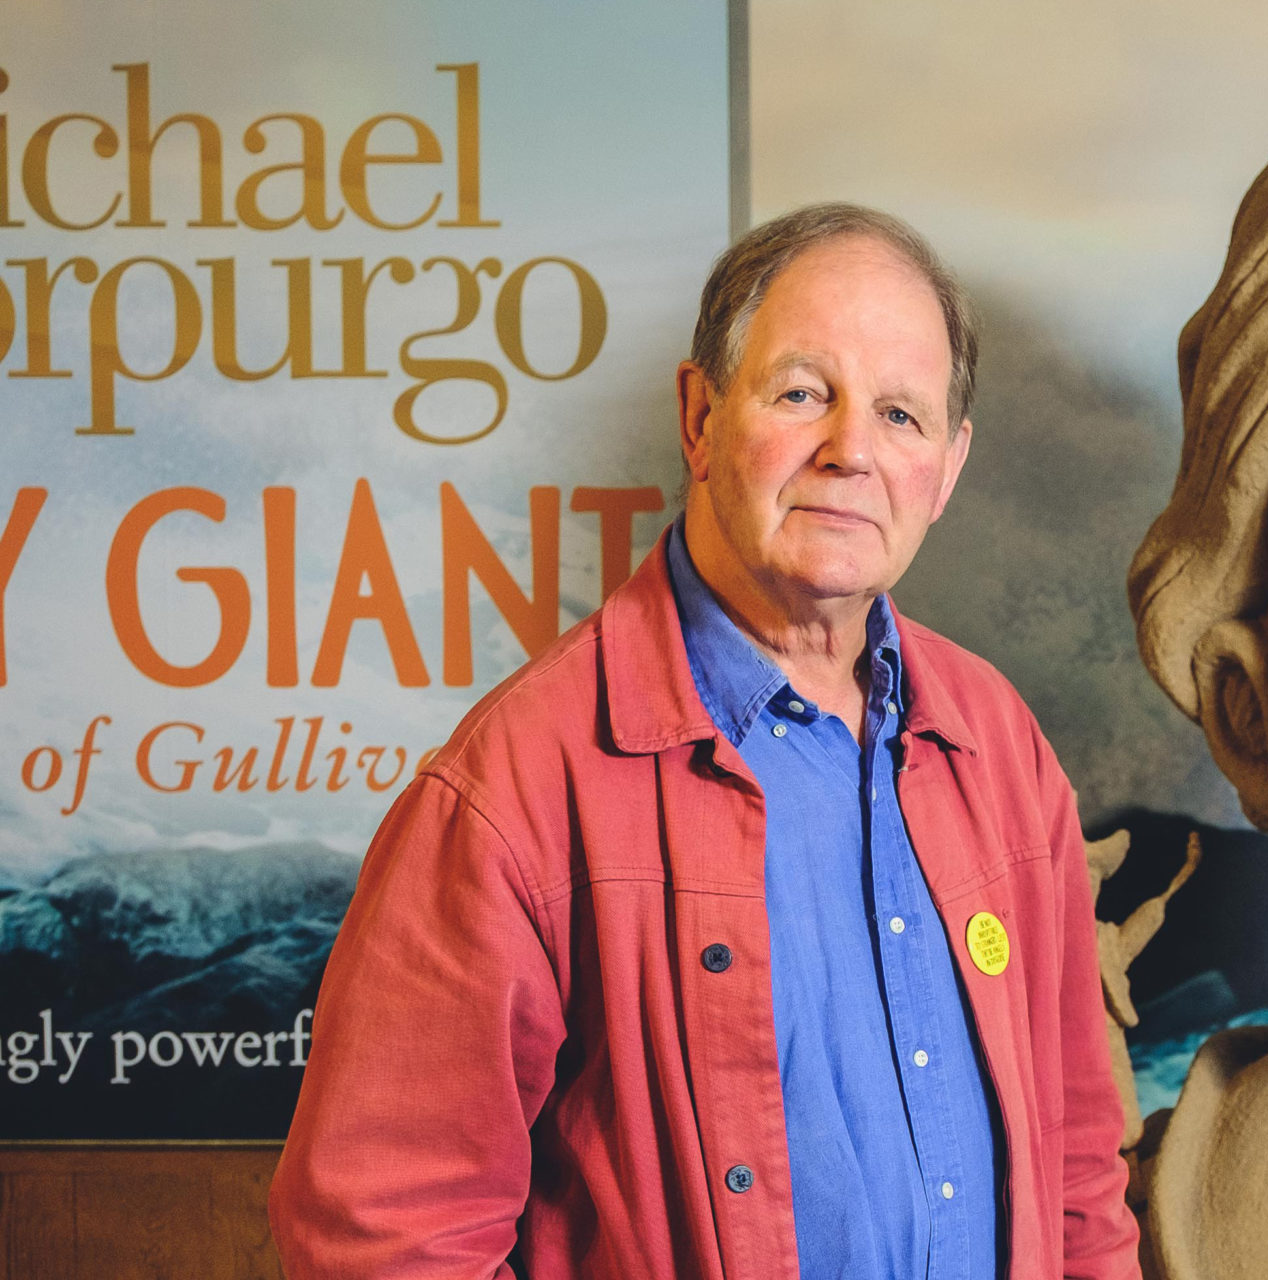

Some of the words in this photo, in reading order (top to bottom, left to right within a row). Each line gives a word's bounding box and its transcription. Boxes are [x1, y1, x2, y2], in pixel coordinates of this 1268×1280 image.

[0, 255, 608, 445] rpurgo
[106, 477, 665, 688] GIANT
[21, 715, 112, 816] of
[0, 1008, 94, 1084] gly
[110, 1008, 314, 1084] powerf
